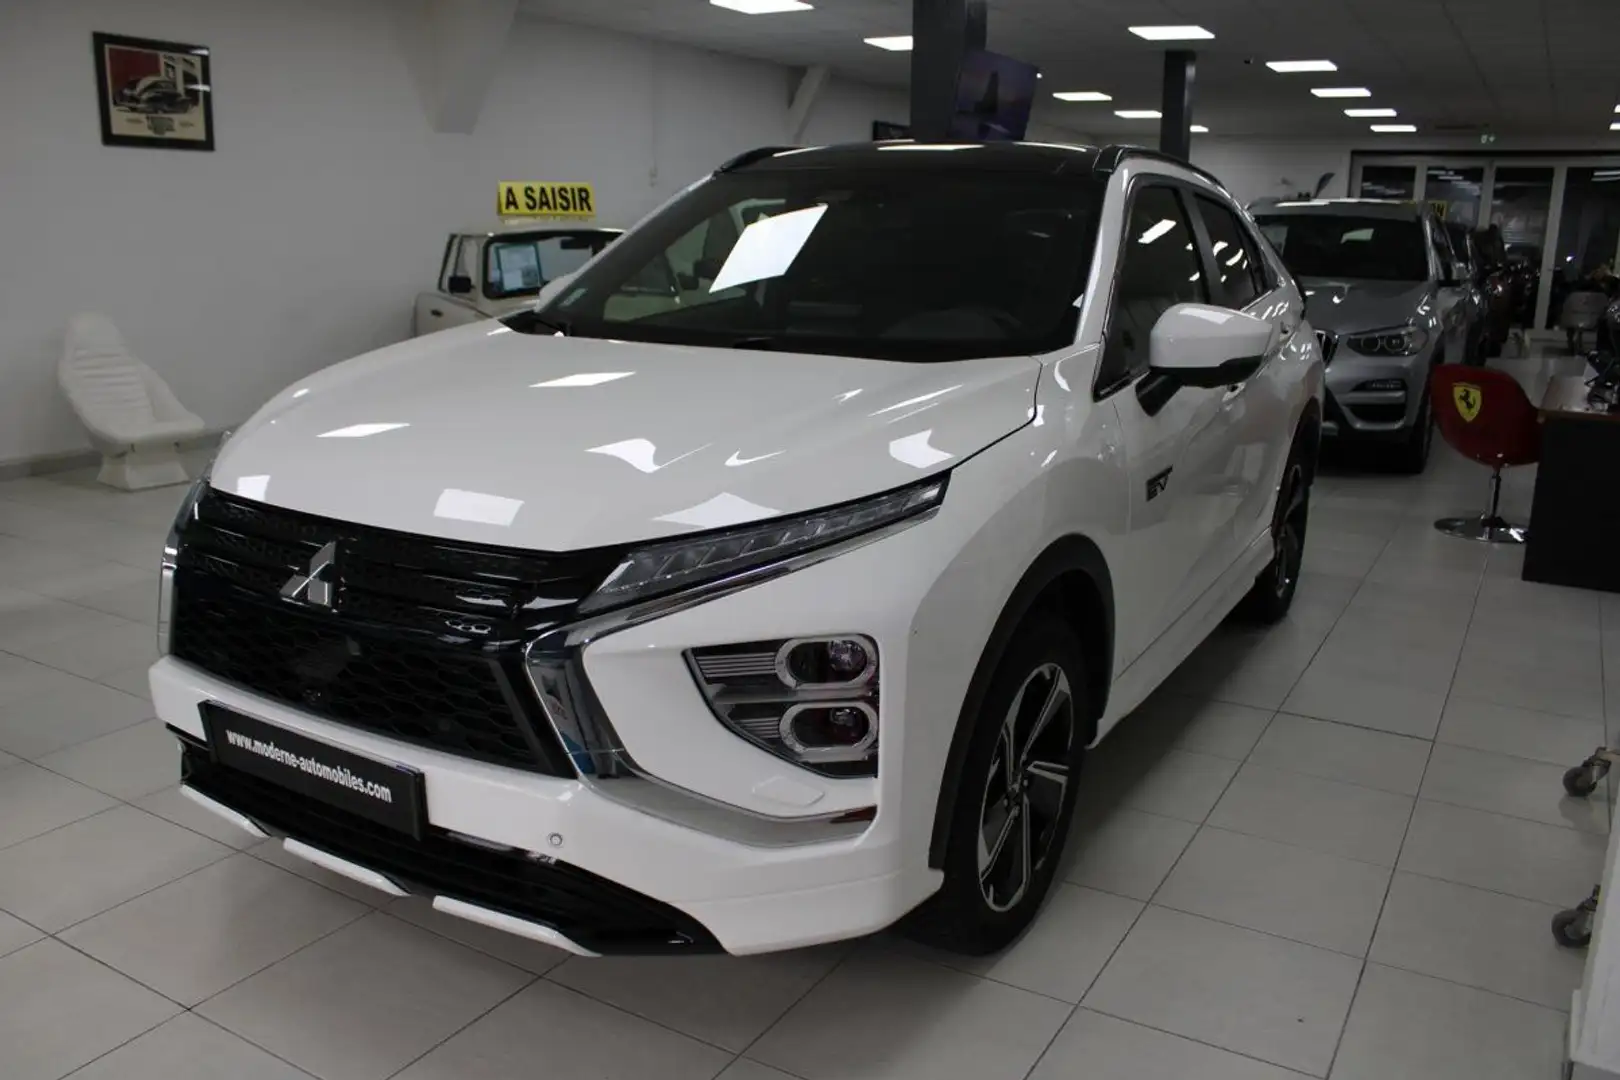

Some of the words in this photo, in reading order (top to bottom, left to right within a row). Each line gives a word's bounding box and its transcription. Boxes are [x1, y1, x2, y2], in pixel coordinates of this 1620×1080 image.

[505, 186, 519, 210] A
[524, 186, 592, 211] SAISIR
[225, 729, 392, 803] www.moderne-automobiles.com
